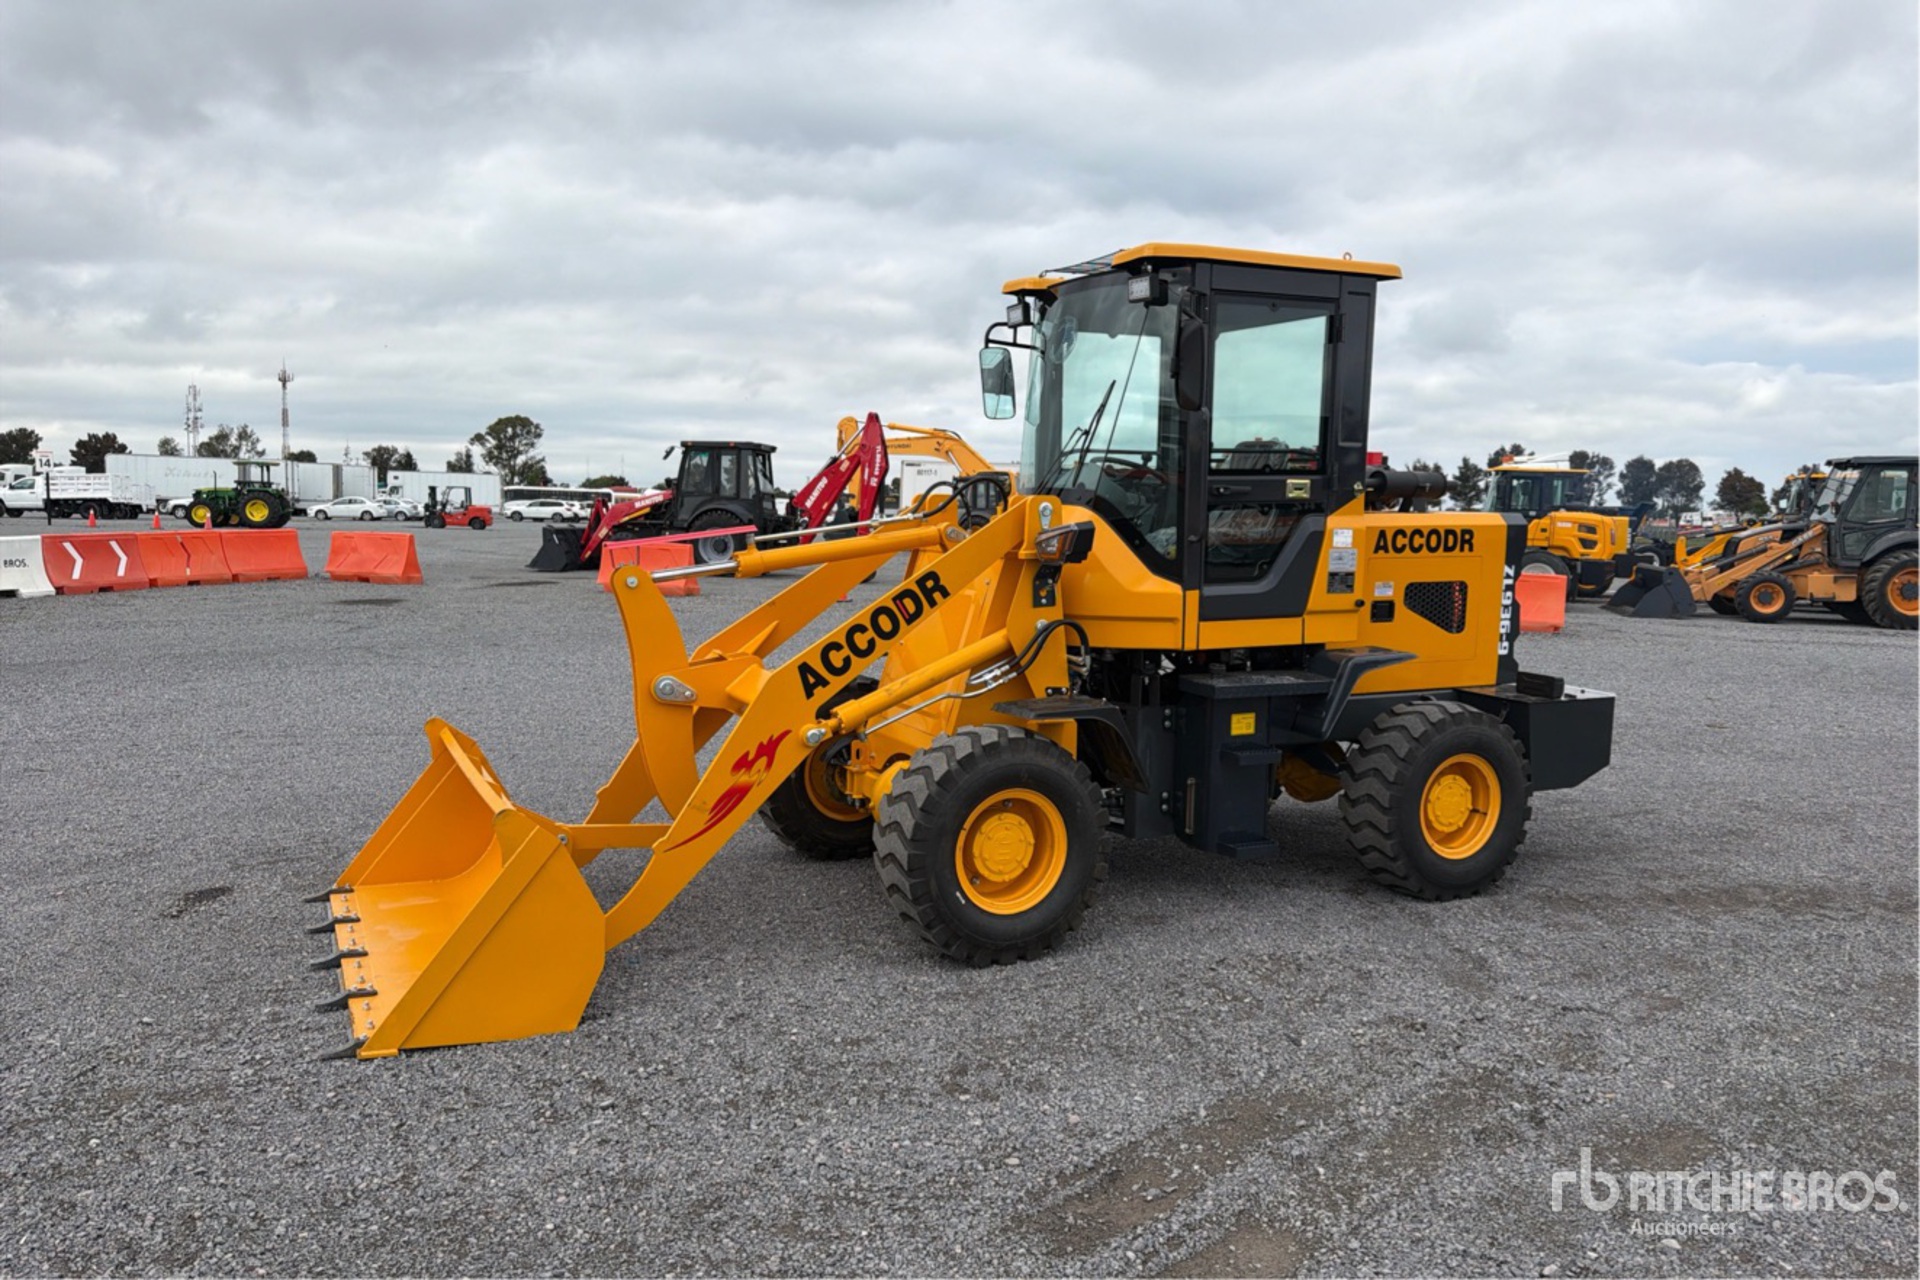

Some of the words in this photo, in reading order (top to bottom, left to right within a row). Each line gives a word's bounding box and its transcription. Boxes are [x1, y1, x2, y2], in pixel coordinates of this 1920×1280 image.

[39, 458, 51, 468] 14
[804, 476, 829, 509] MANITOU
[1373, 528, 1475, 554] ACCODR
[1497, 564, 1516, 656] ZL936-9
[797, 570, 951, 700] ACCODR
